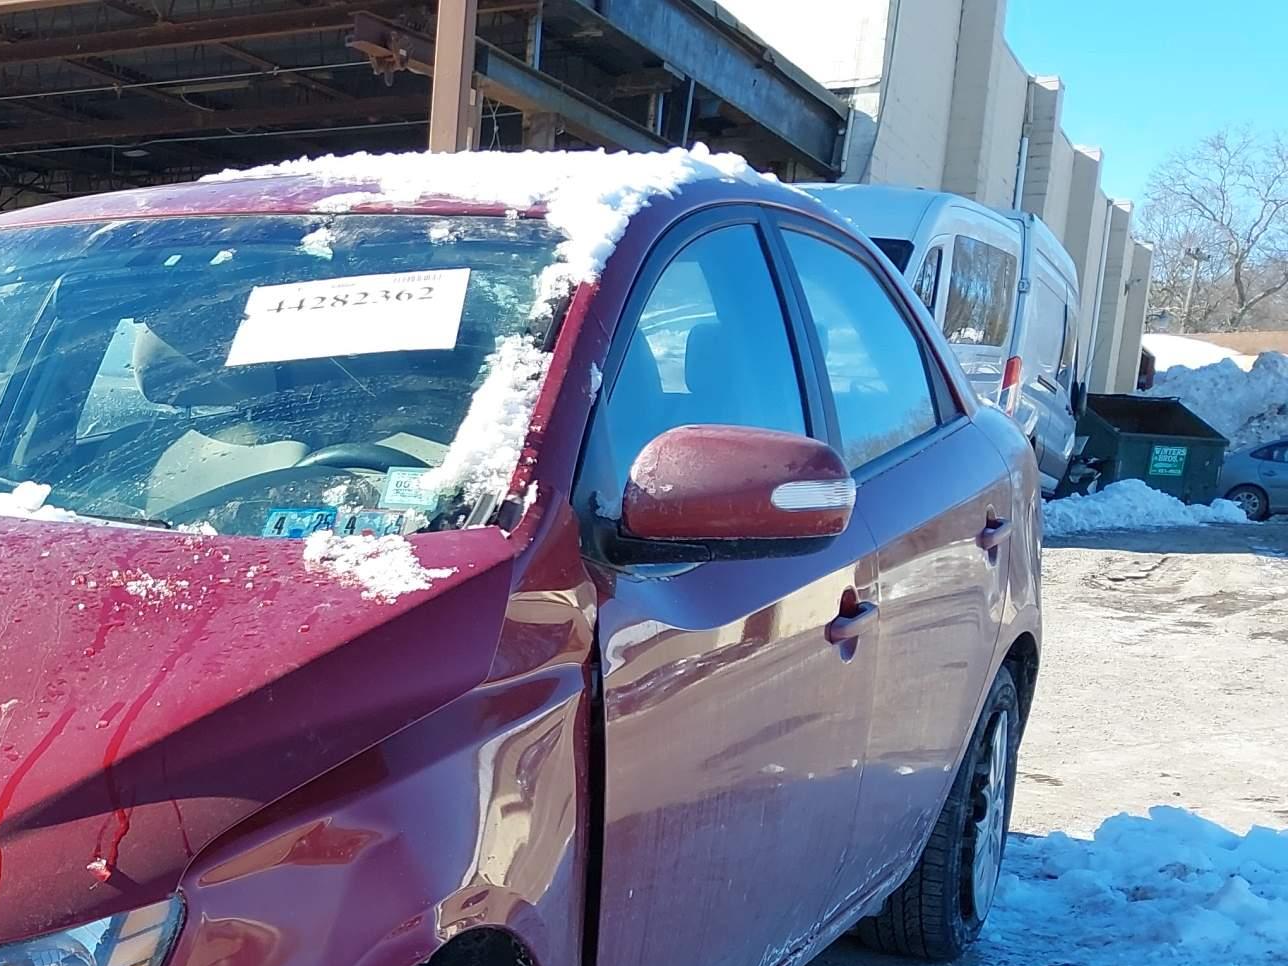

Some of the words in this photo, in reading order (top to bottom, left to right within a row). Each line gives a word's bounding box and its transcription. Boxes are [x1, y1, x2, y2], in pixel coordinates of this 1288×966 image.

[267, 286, 435, 313] 44282362
[1154, 447, 1187, 456] WINTERS
[272, 516, 287, 535] 4
[343, 515, 357, 536] 4
